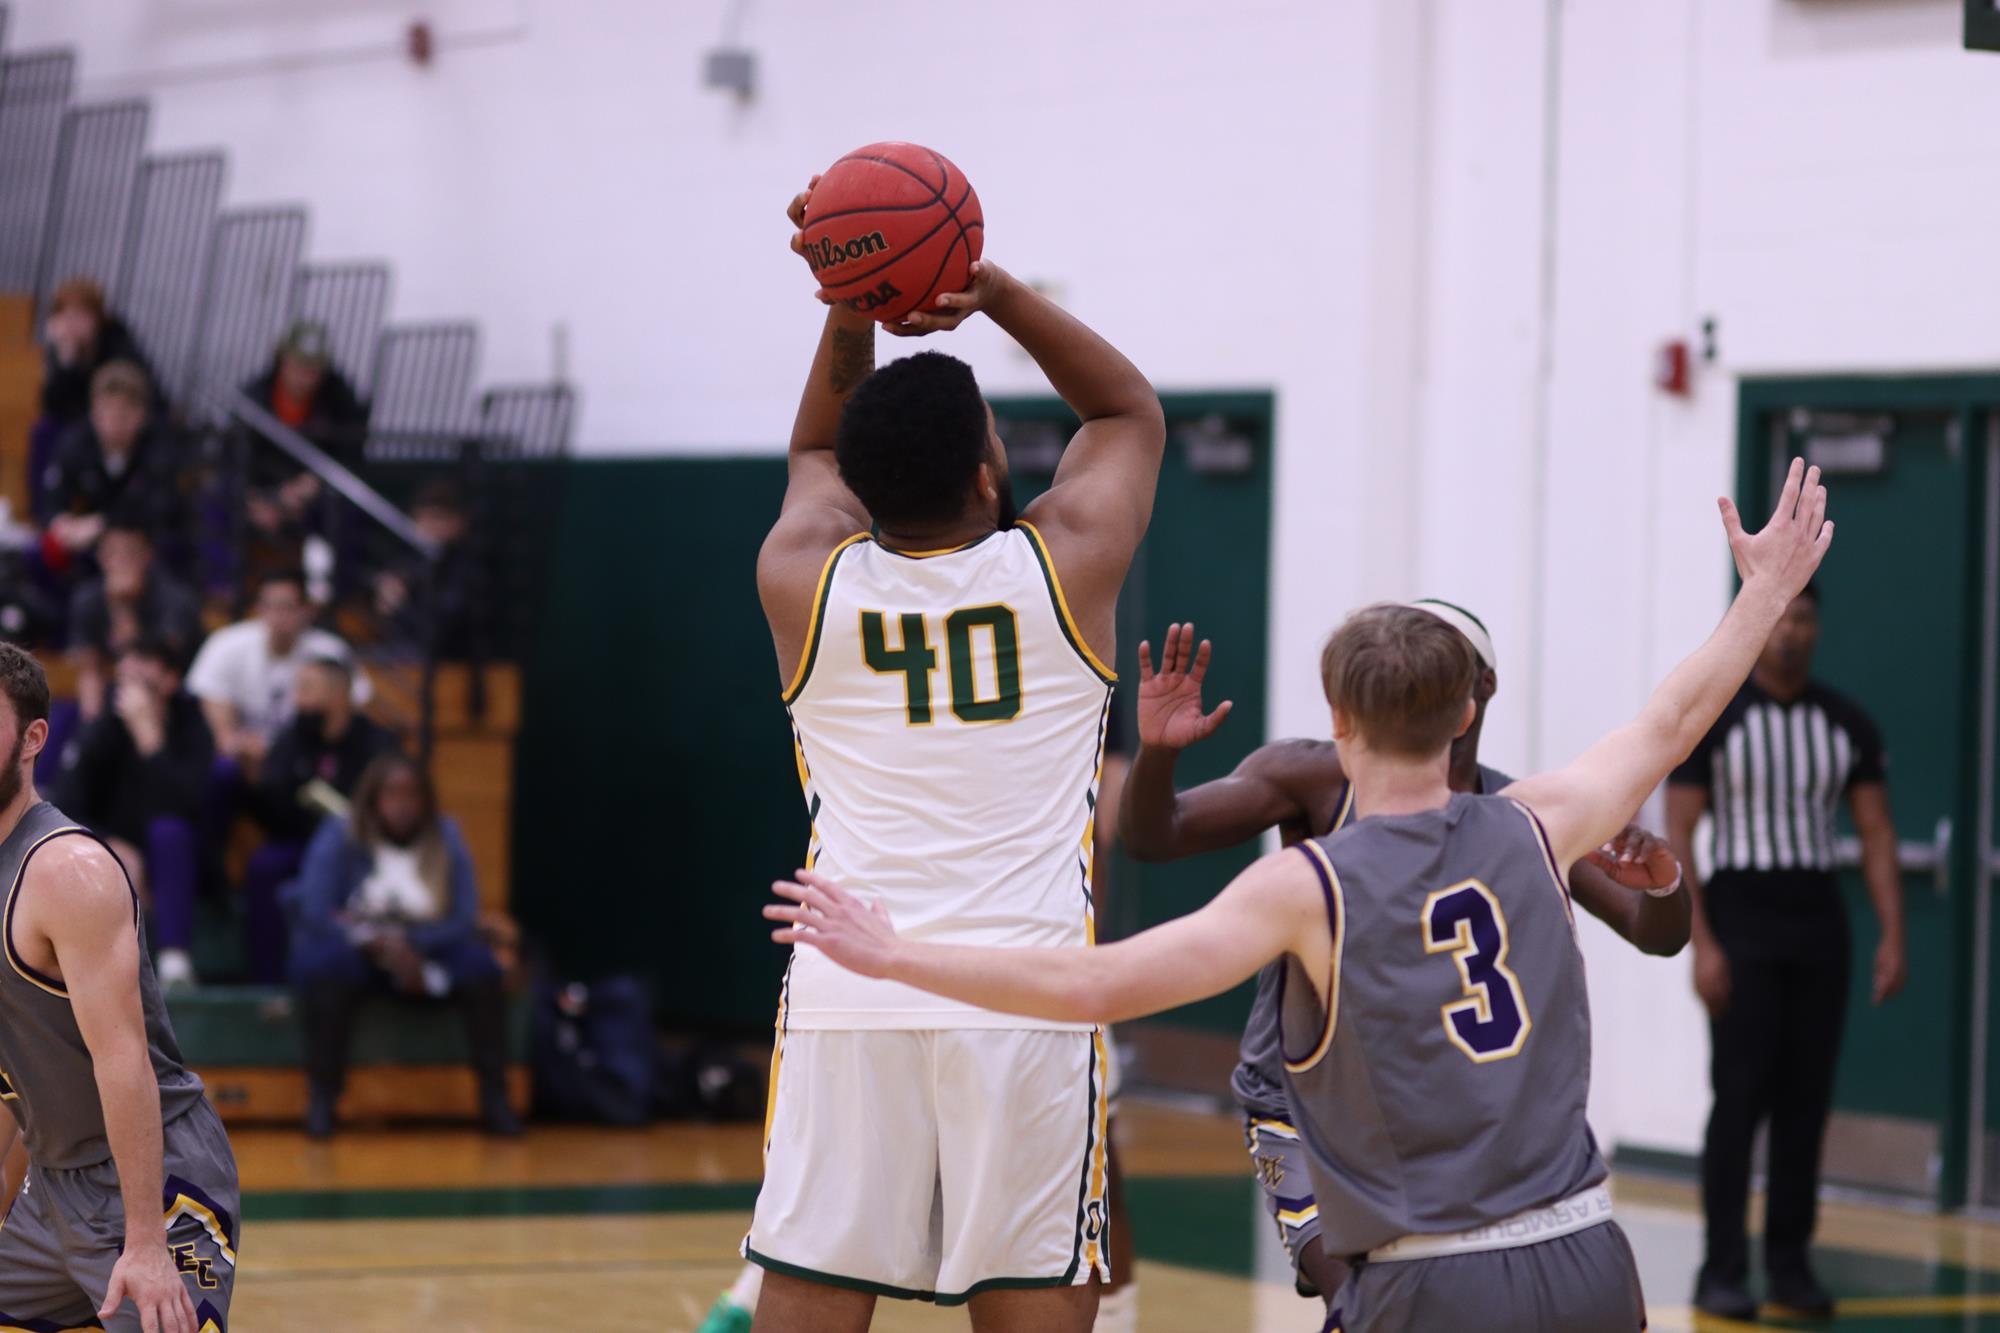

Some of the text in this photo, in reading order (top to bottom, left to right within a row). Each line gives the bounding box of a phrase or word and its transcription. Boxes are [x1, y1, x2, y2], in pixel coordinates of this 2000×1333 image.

[841, 280, 902, 311] CAA
[858, 602, 1024, 727] 40
[1421, 878, 1533, 1064] 3
